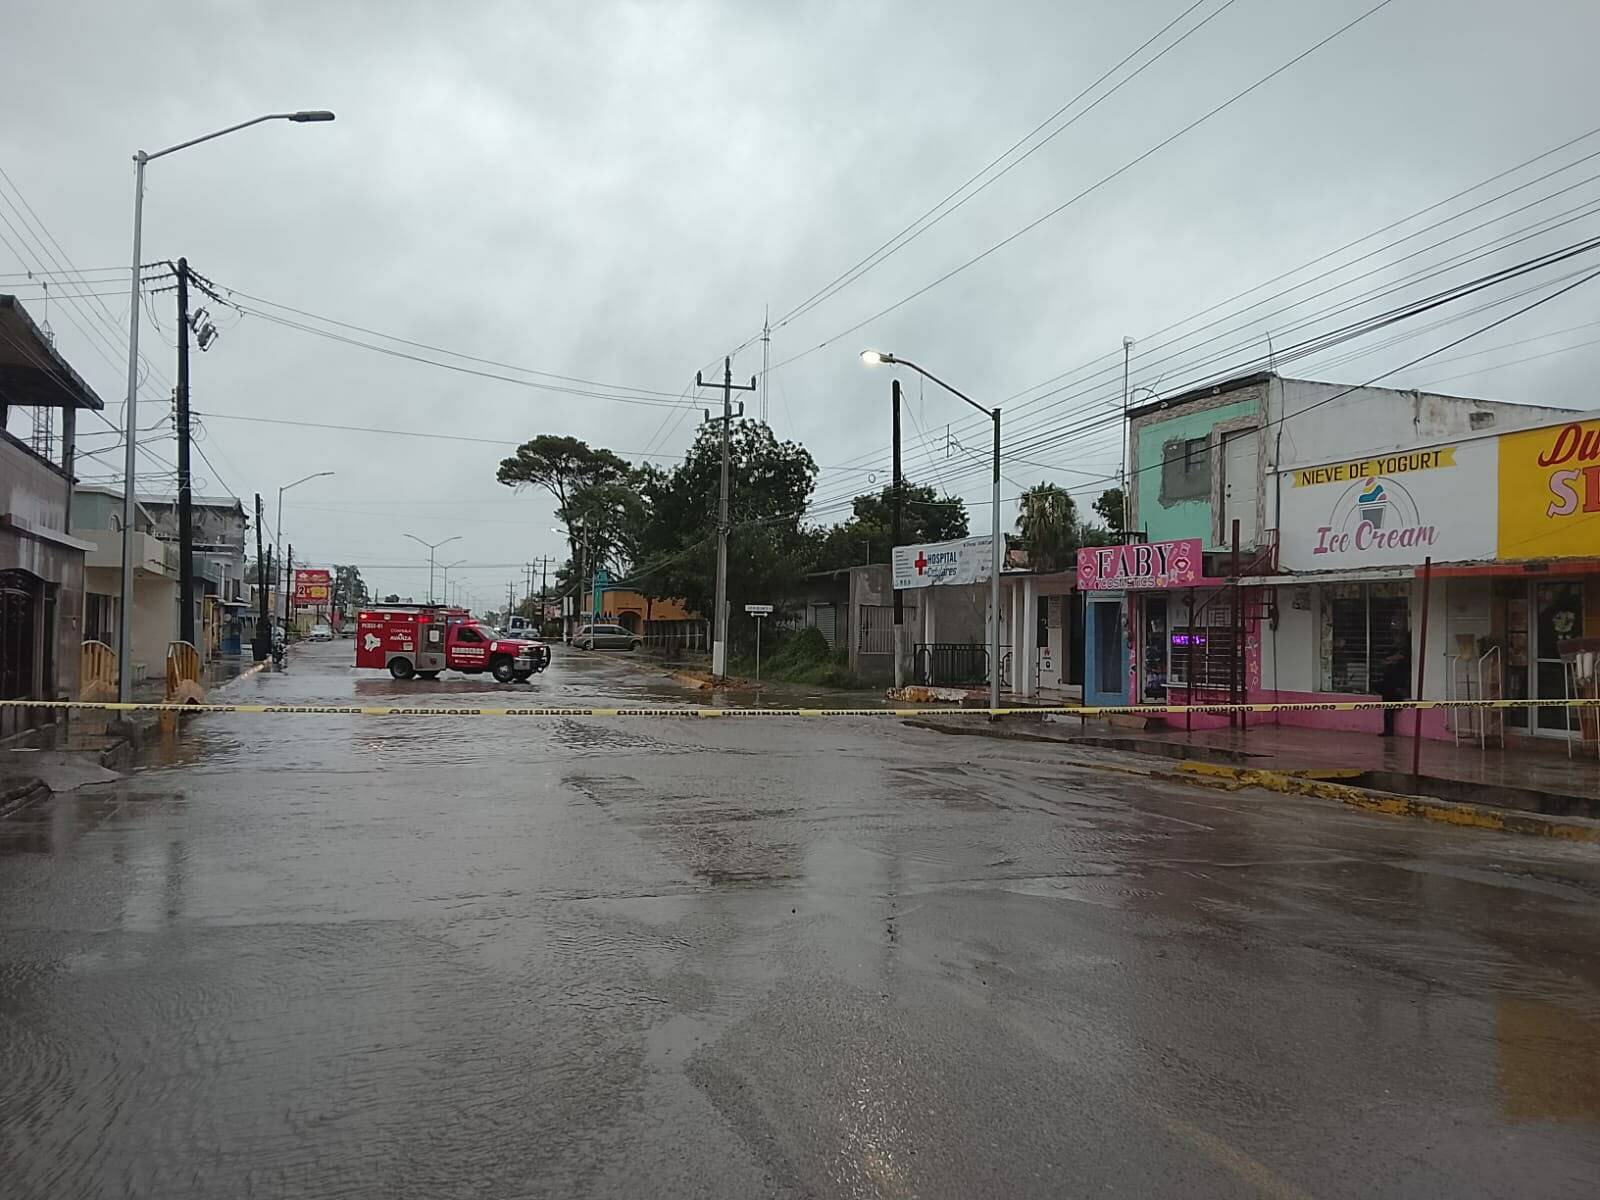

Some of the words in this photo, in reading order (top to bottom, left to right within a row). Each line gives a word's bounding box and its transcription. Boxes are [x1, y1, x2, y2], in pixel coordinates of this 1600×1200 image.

[1302, 465, 1343, 486] NIEVE
[1349, 461, 1369, 479] DE
[1377, 450, 1442, 475] YOGURT
[1313, 526, 1350, 555] Ice
[1355, 520, 1438, 551] Cream
[927, 551, 957, 565] HOSPITAL
[1096, 543, 1174, 580] FABY
[1101, 576, 1156, 590] COSMETICS
